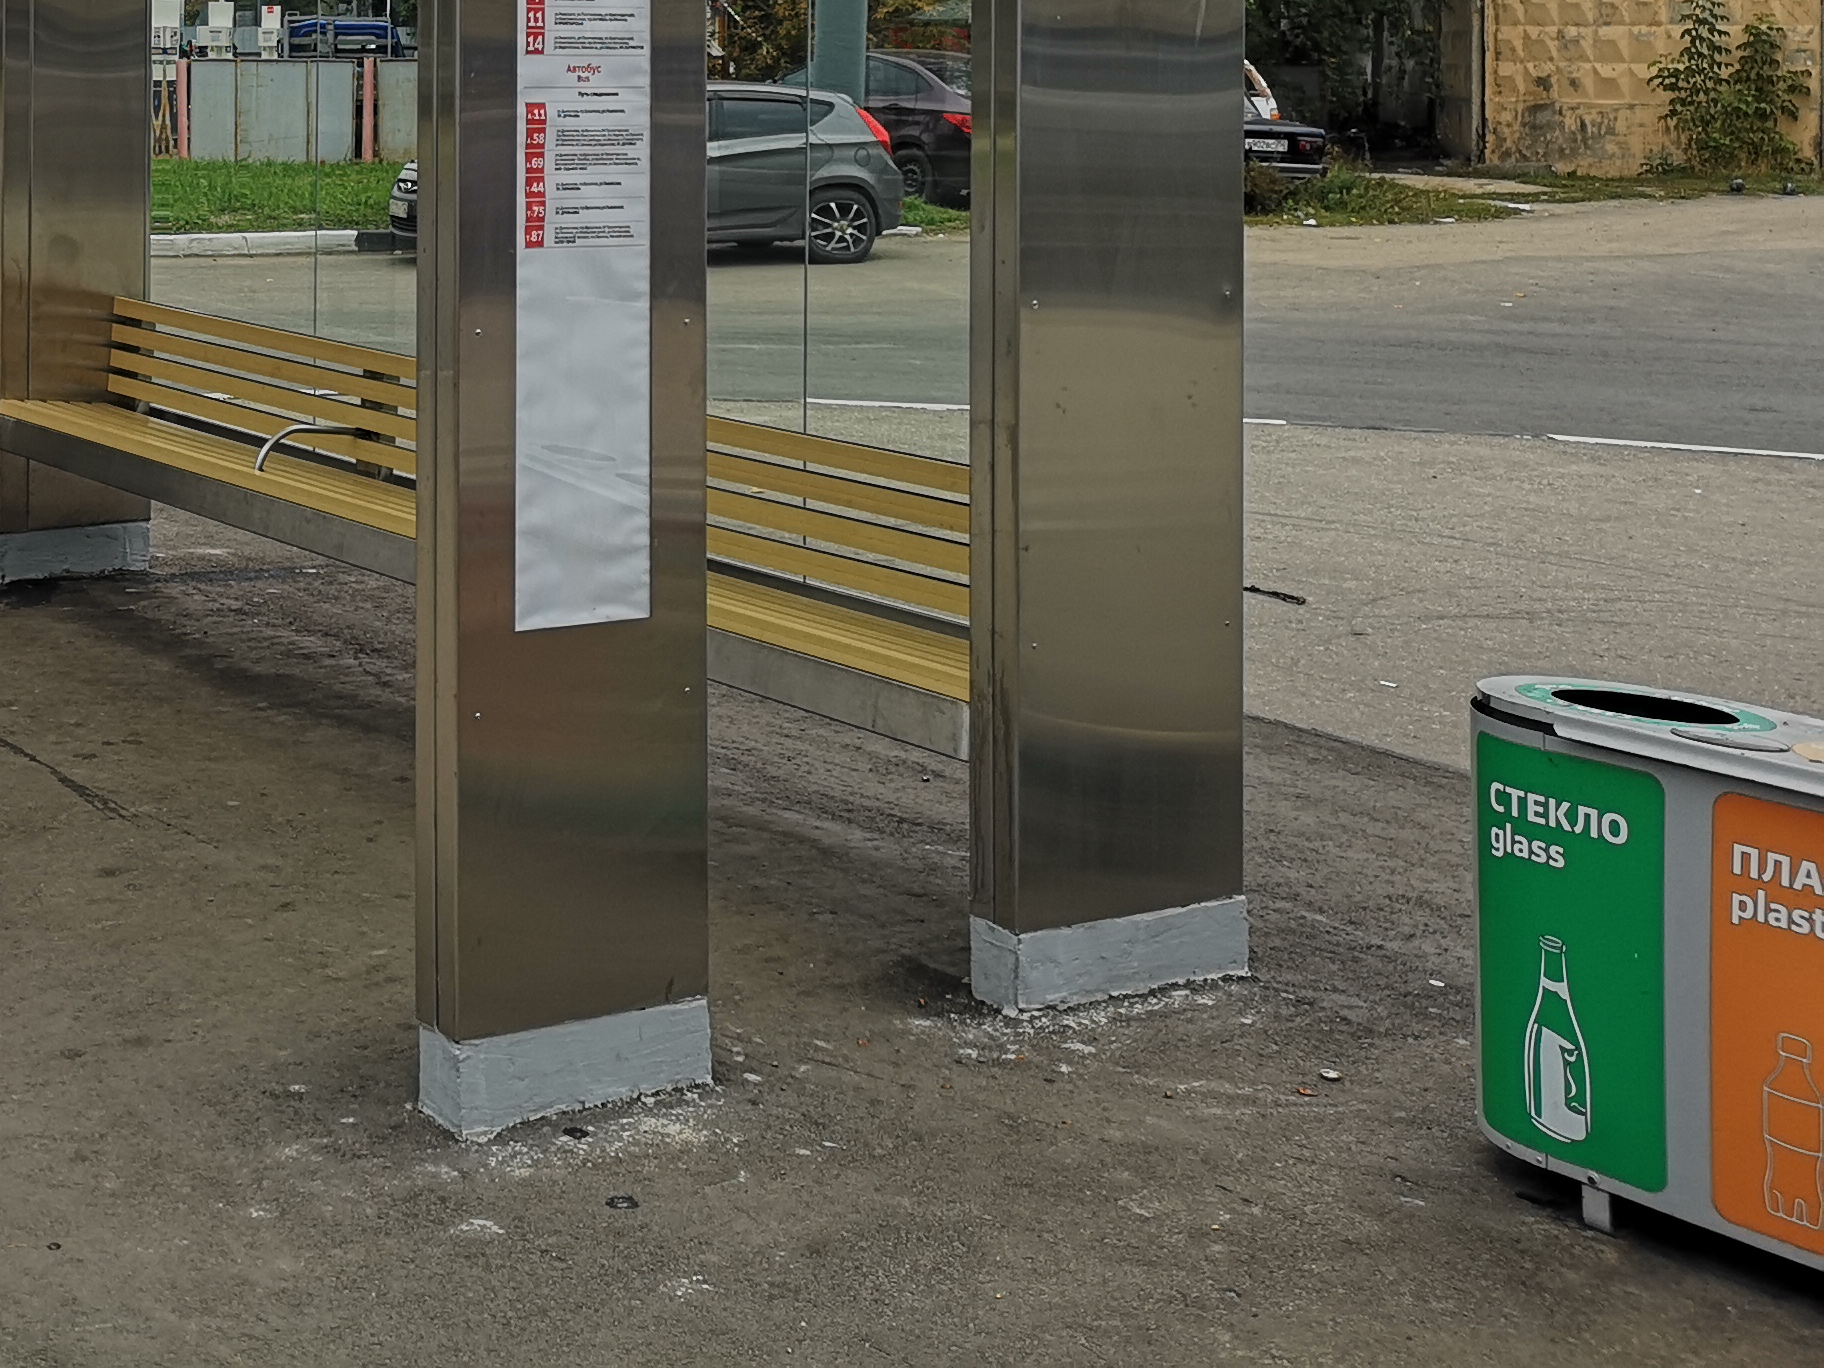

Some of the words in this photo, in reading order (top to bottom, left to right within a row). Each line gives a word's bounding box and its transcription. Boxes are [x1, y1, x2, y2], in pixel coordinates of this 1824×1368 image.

[527, 11, 544, 27] 11
[527, 35, 544, 51] 14
[566, 63, 602, 75] Автобус
[1489, 781, 1629, 845] СТЕКЛО
[1489, 822, 1566, 869] glass
